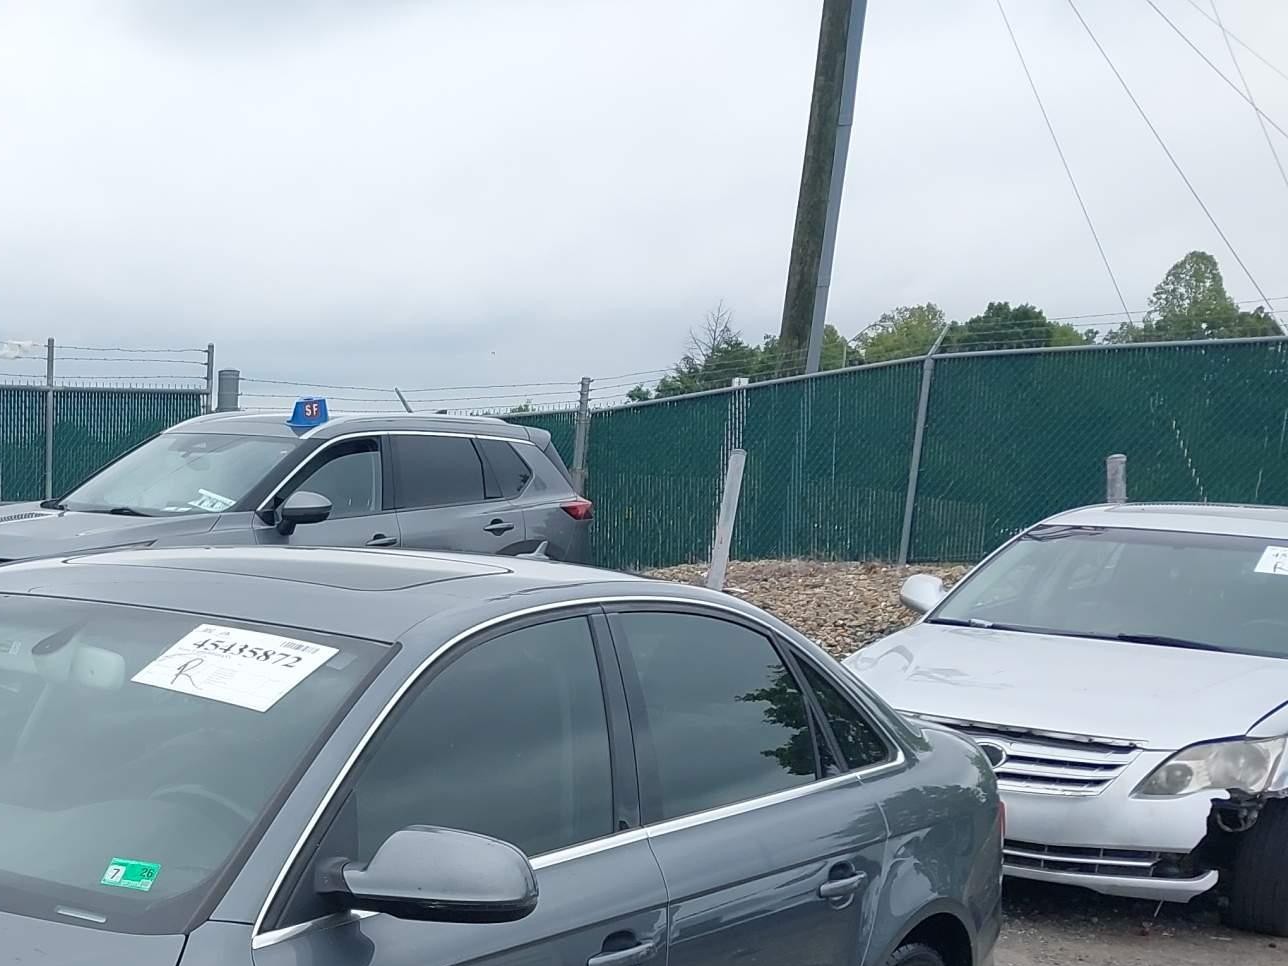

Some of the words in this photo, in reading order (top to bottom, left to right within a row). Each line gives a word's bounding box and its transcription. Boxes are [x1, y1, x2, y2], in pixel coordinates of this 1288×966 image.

[193, 638, 302, 668] 45435872
[111, 868, 120, 880] 7
[140, 867, 154, 878] 26
